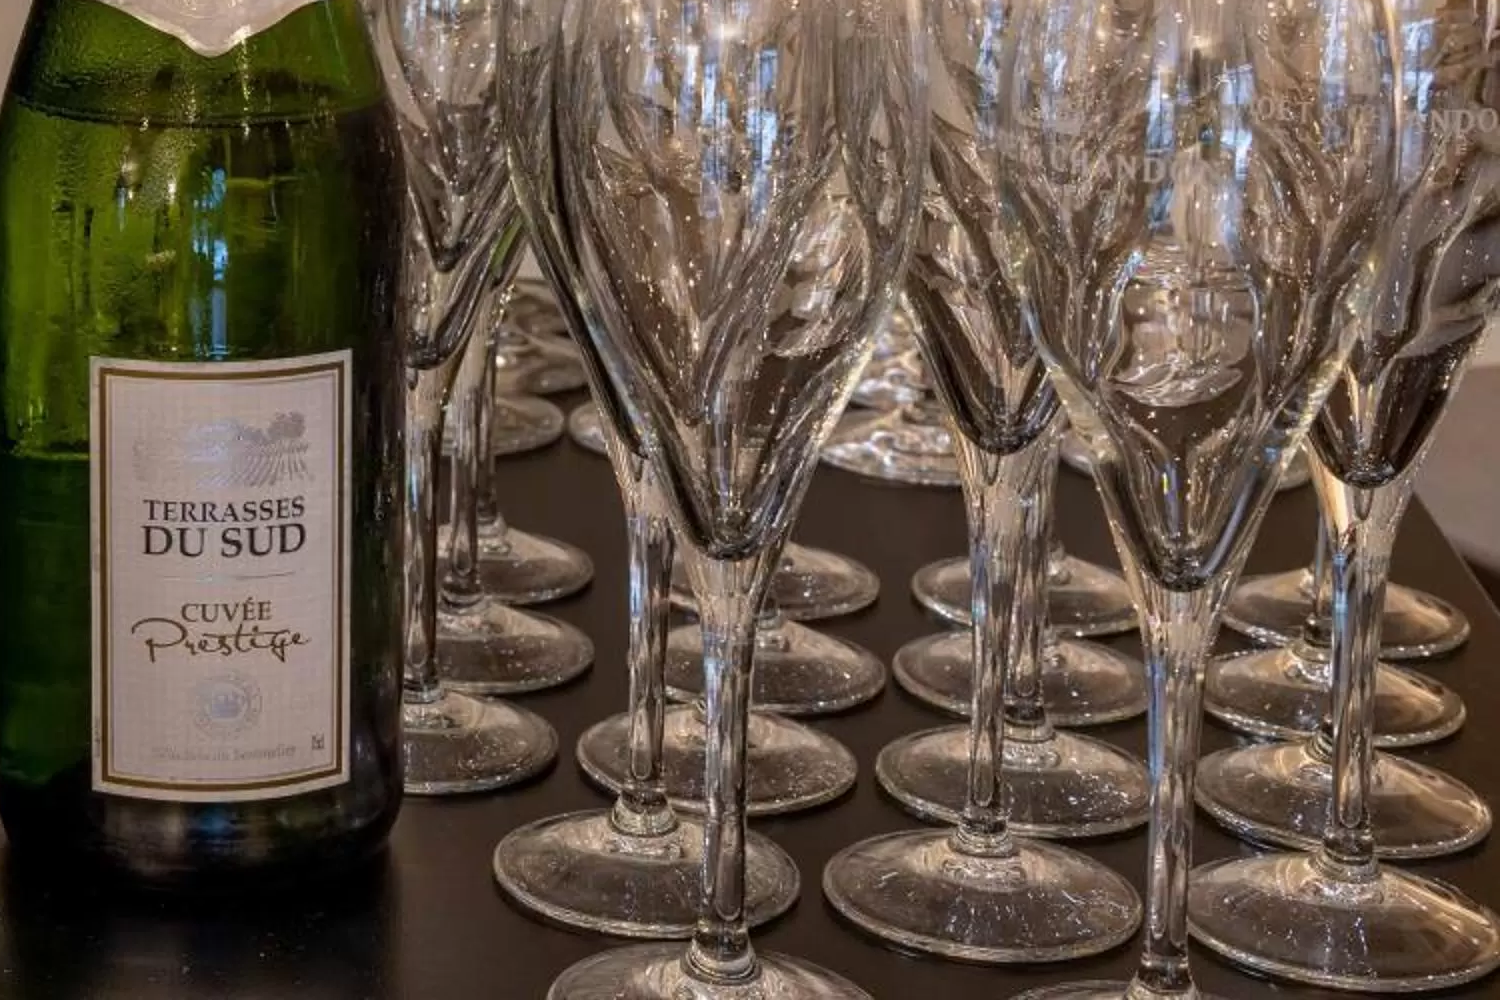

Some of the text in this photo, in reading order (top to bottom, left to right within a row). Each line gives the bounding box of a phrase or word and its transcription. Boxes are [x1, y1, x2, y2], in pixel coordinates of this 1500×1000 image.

[143, 495, 306, 523] TERRASSES
[142, 522, 307, 558] DU SUD
[181, 596, 272, 624] CUVÉE
[130, 617, 311, 663] Prestige
